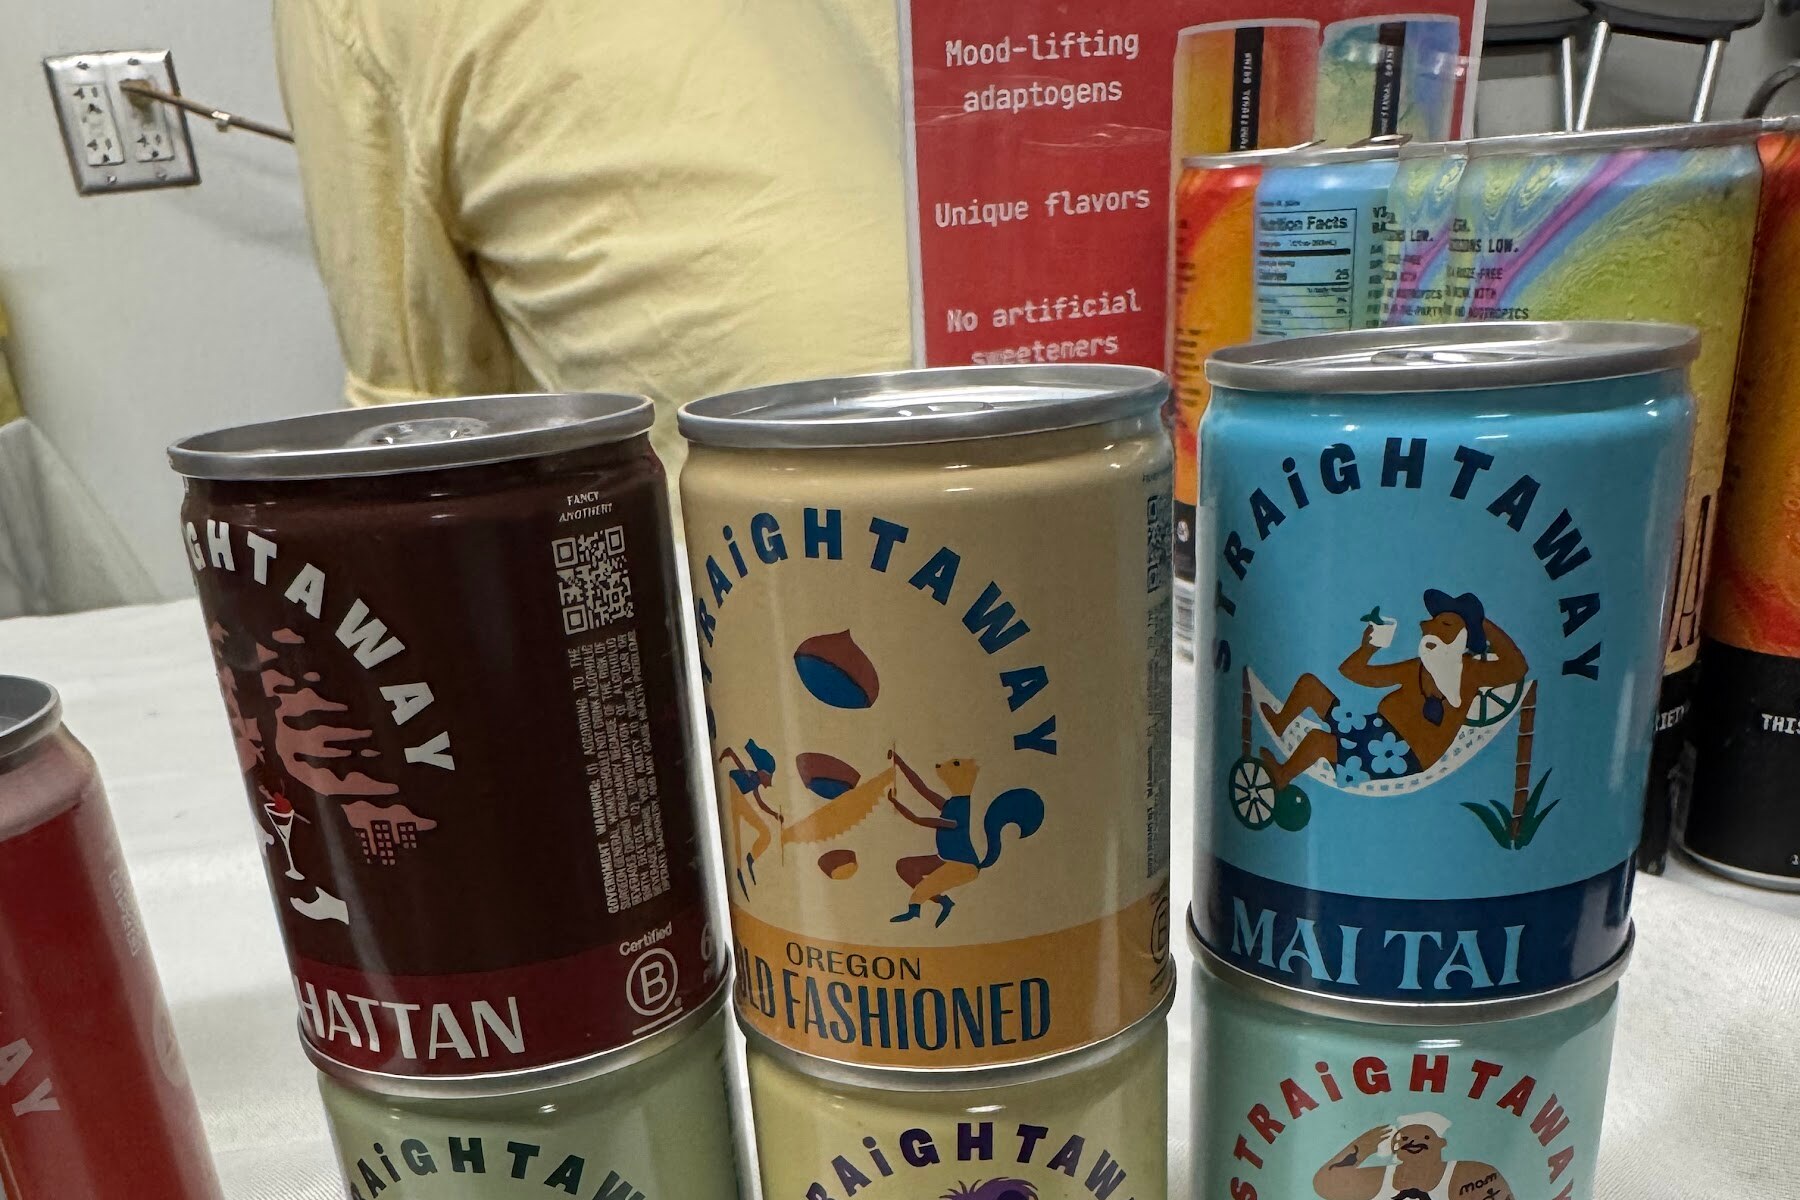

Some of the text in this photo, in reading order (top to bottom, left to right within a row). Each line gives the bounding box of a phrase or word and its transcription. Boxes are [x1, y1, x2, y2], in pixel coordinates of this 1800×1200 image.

[946, 29, 1139, 67] Mood-lifting
[963, 80, 1123, 114] adaptogens
[935, 189, 1151, 228] Unique flavors
[1306, 215, 1348, 230] Facts
[1488, 238, 1519, 253] LOW.
[1335, 268, 1350, 281] 25
[947, 287, 1142, 333] No artificial
[971, 335, 1119, 365] sweeteners
[598, 842, 619, 913] GOVERNMENT
[619, 921, 672, 956] Certified
[1231, 895, 1360, 987] MAI
[1383, 924, 1526, 990] TAI
[786, 942, 921, 980] OREGON
[782, 969, 1050, 1051] FASHIONED
[1459, 1172, 1498, 1196] mom
